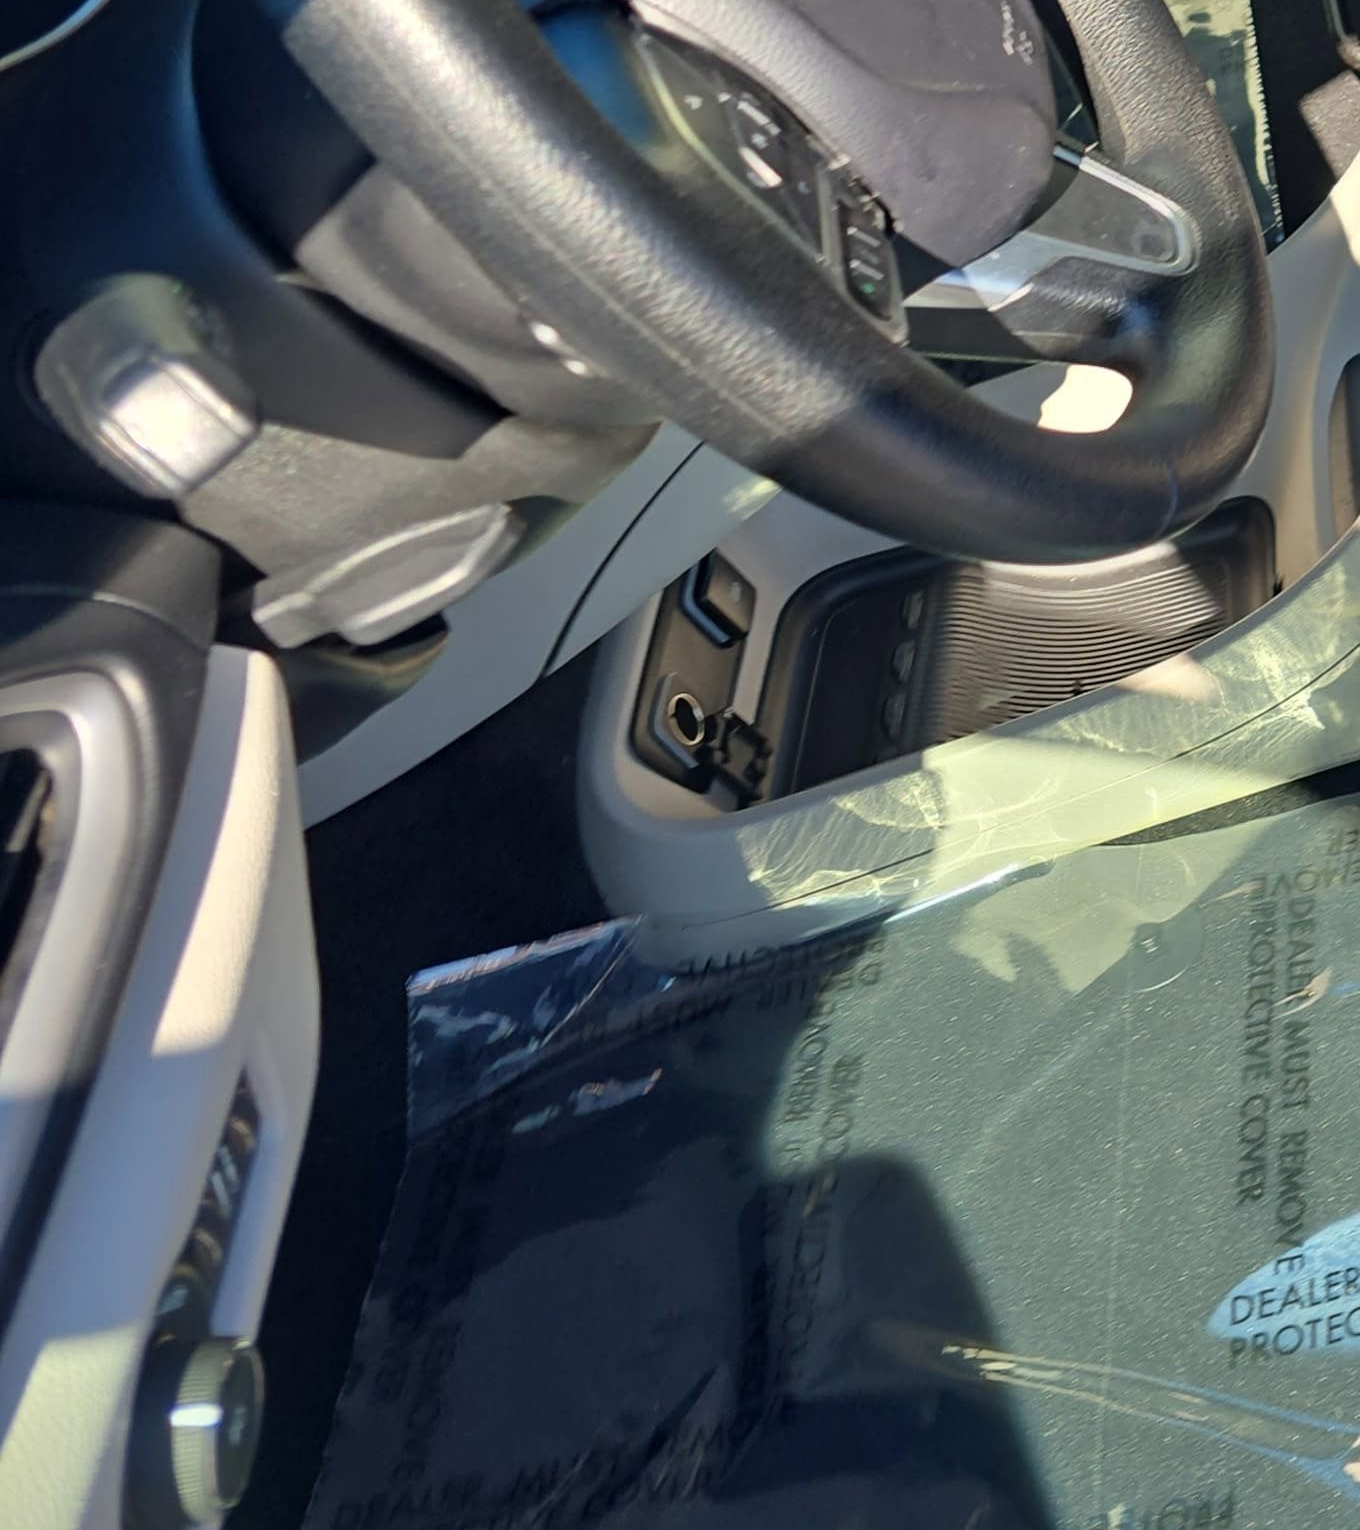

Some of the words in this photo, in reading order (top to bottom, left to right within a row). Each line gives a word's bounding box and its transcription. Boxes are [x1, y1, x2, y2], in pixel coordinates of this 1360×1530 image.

[1243, 902, 1277, 1084] PROTECTIVE
[1286, 894, 1316, 1010] DEALER
[1281, 1020, 1311, 1110] MUST
[1236, 1094, 1270, 1208] COVER
[1273, 1129, 1307, 1276] REMOVE
